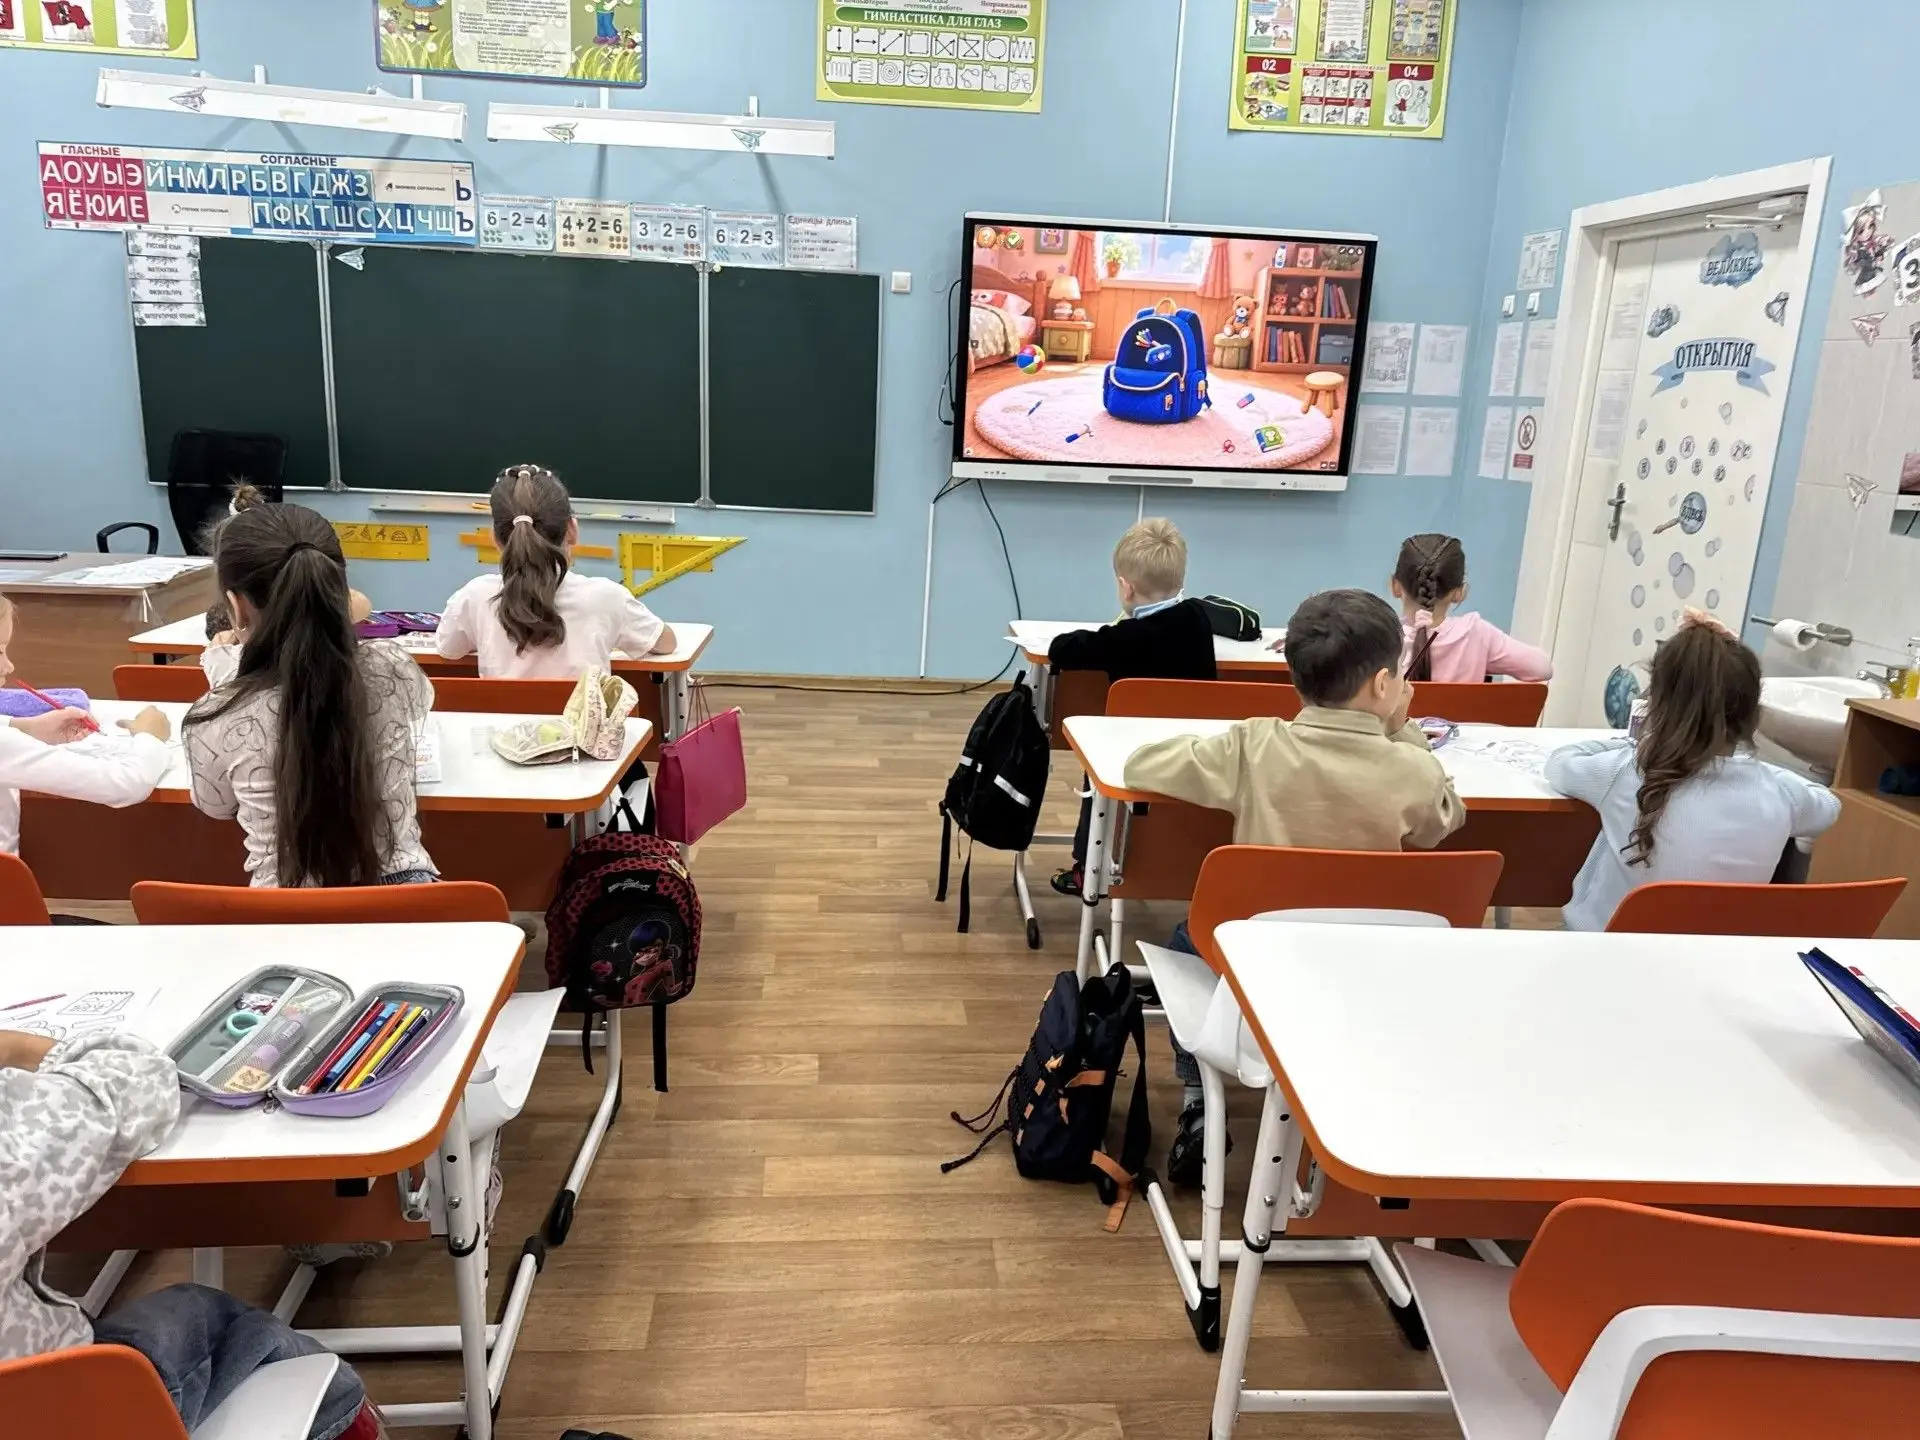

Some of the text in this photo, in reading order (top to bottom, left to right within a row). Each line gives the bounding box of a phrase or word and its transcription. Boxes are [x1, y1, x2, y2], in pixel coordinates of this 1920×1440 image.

[863, 10, 1001, 28] ГИМНАСТИКА ДЛЯ ГЛАЗ
[1261, 59, 1277, 71] 02
[1404, 65, 1419, 78] 04
[61, 145, 121, 157] ГЛАСНЫЕ
[260, 154, 337, 167] СОГЛАСНЫЕ
[788, 215, 852, 226] Единицы длины
[1706, 256, 1755, 277] ВЕЛИКИЕ
[1675, 341, 1754, 369] ОТКРЫТИЯ
